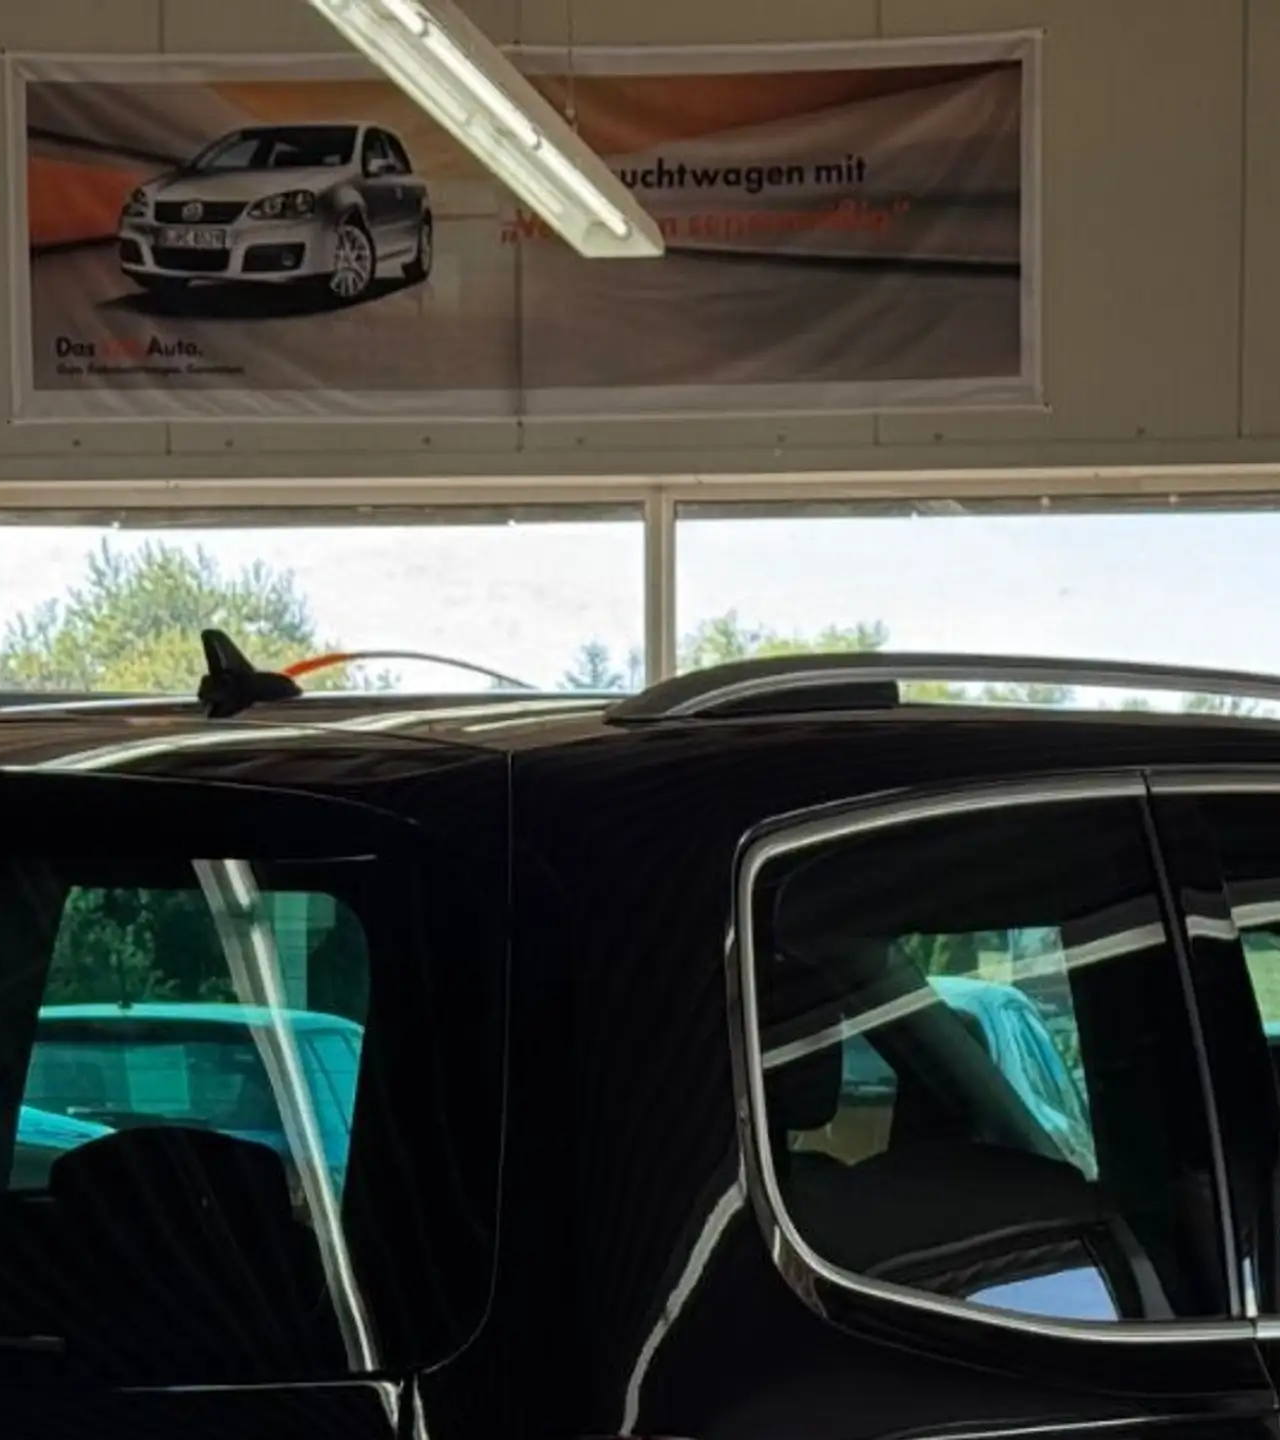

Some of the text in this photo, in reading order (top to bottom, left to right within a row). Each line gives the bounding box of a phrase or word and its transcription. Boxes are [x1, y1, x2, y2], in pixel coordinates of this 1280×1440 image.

[619, 154, 867, 193] uchtwagen mit
[56, 336, 95, 358] Das
[146, 335, 204, 358] Auto.
